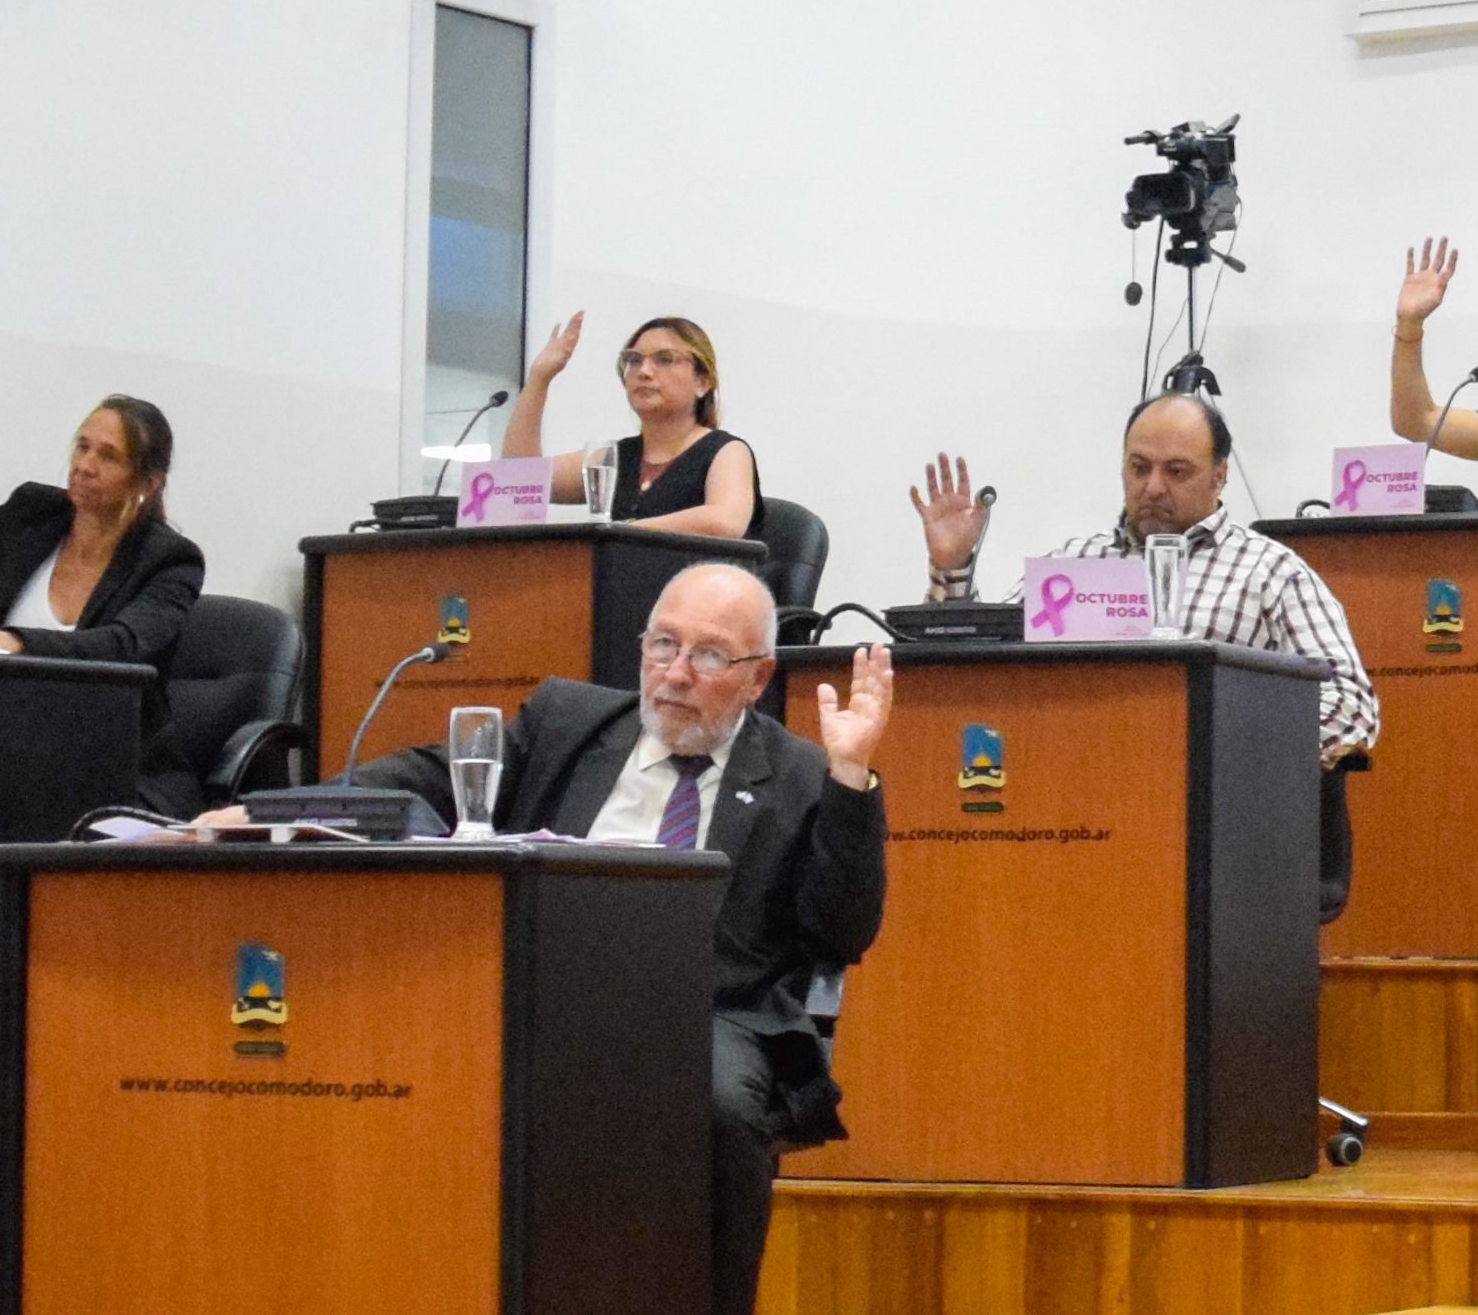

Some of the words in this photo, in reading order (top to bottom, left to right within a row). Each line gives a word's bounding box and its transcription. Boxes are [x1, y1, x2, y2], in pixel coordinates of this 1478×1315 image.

[1366, 471, 1419, 483] OCTUBRE
[493, 485, 543, 496] OCTUBRE
[1386, 483, 1417, 494] ROSA
[513, 496, 543, 505] ROSA
[1075, 593, 1148, 605] OCTUBRE
[1105, 607, 1149, 618] ROSA
[119, 1077, 412, 1102] www.concejocomodoro.gob.ar
